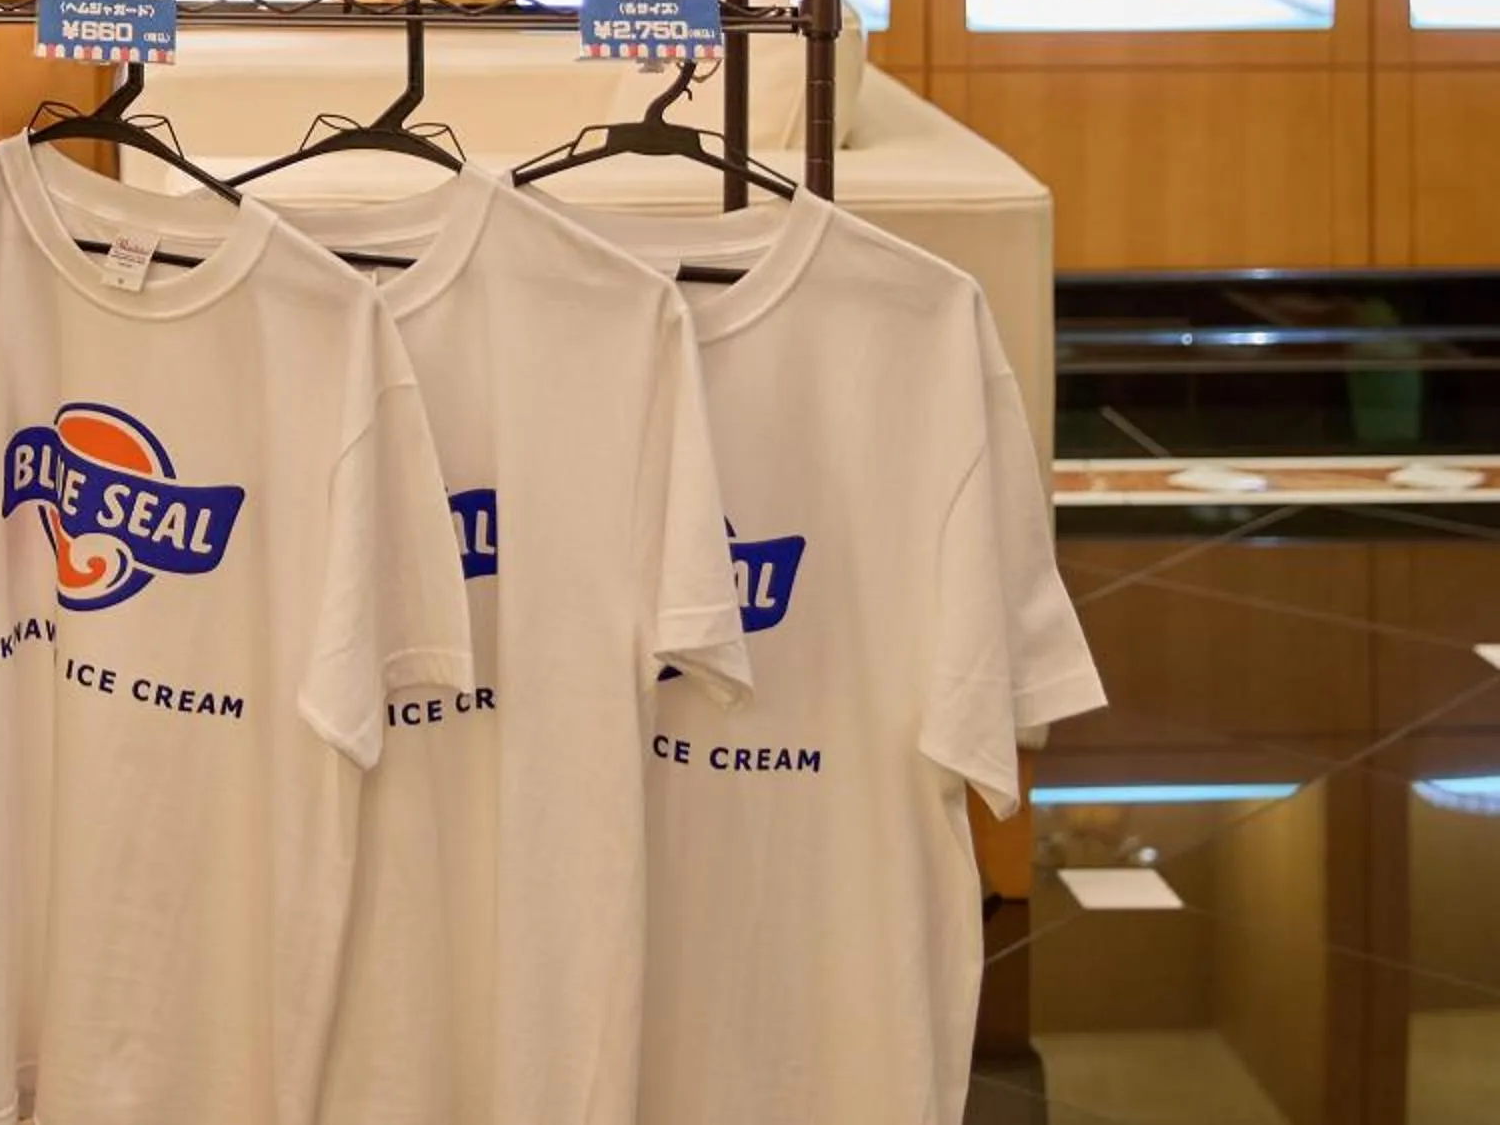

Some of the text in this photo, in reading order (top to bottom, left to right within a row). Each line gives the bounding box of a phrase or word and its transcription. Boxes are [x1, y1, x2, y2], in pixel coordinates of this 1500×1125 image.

[62, 20, 133, 42] ¥660
[97, 484, 213, 554] SEAL
[65, 659, 117, 693] ICE
[132, 679, 244, 718] CREAM
[387, 699, 443, 727] ICE
[653, 735, 822, 773] CE CREAM
